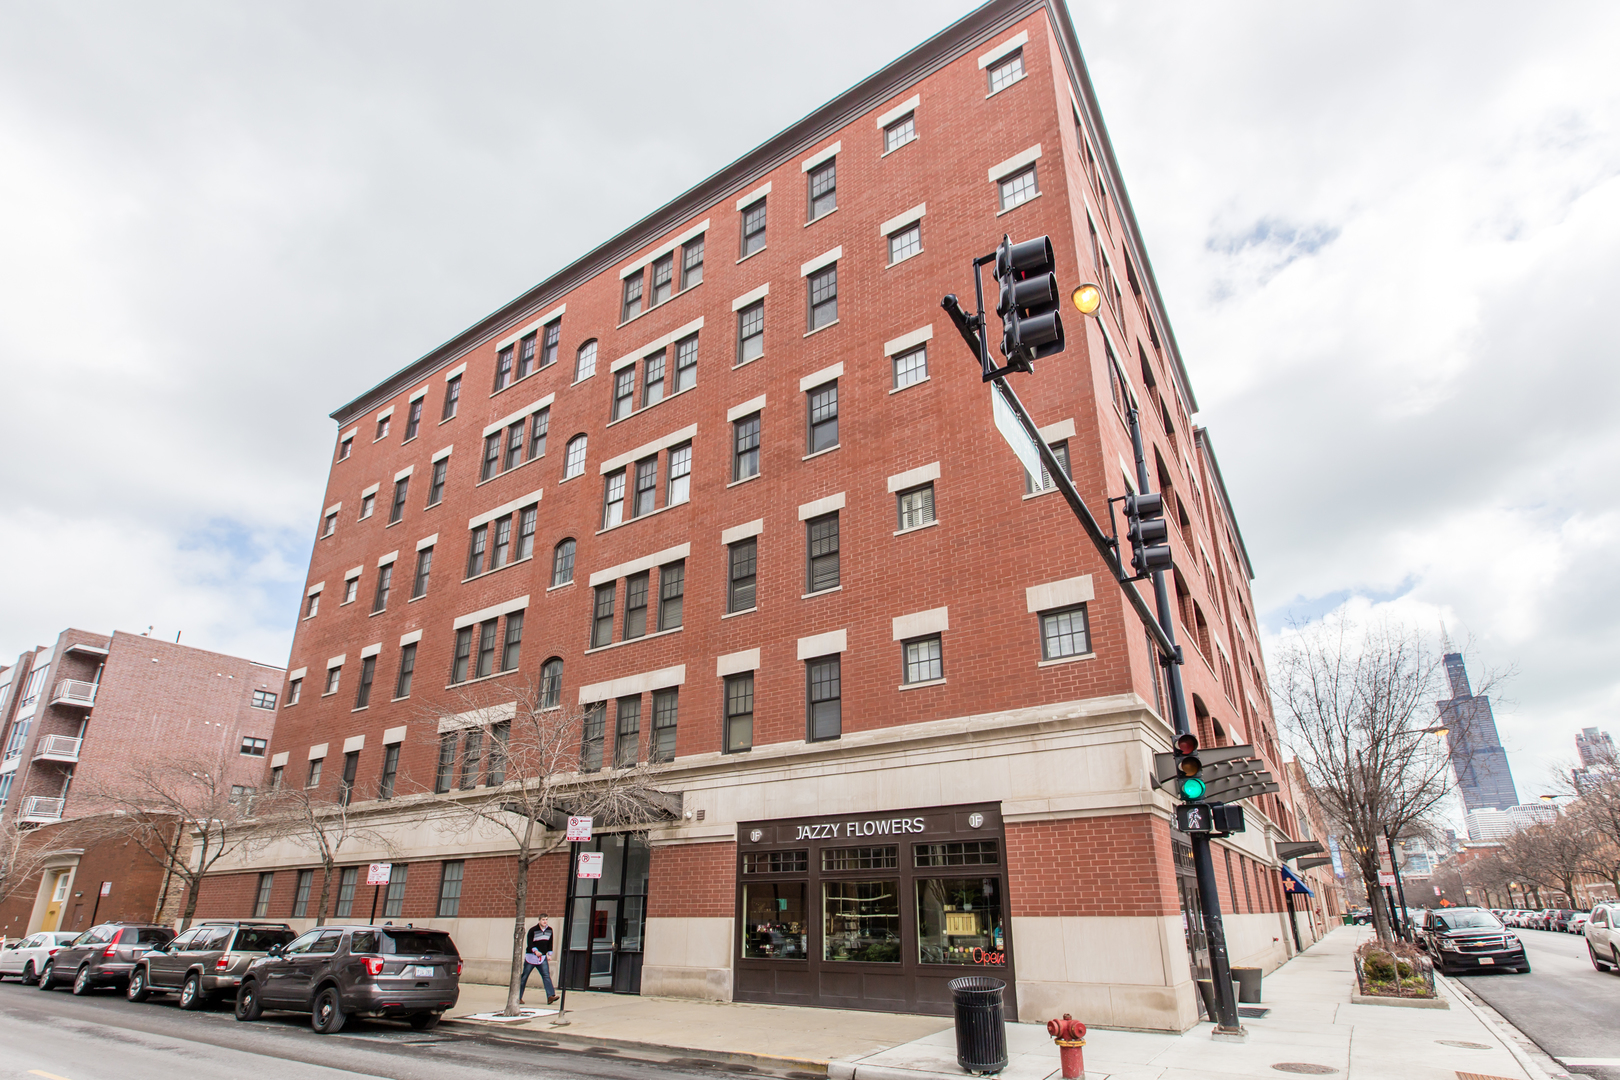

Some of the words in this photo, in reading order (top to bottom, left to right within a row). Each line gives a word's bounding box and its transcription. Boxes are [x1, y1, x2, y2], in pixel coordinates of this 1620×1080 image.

[795, 823, 840, 840] JAZZY
[846, 817, 925, 837] FLOWERS
[970, 815, 982, 827] JF
[751, 831, 761, 841] JF
[973, 947, 1005, 966] Open
